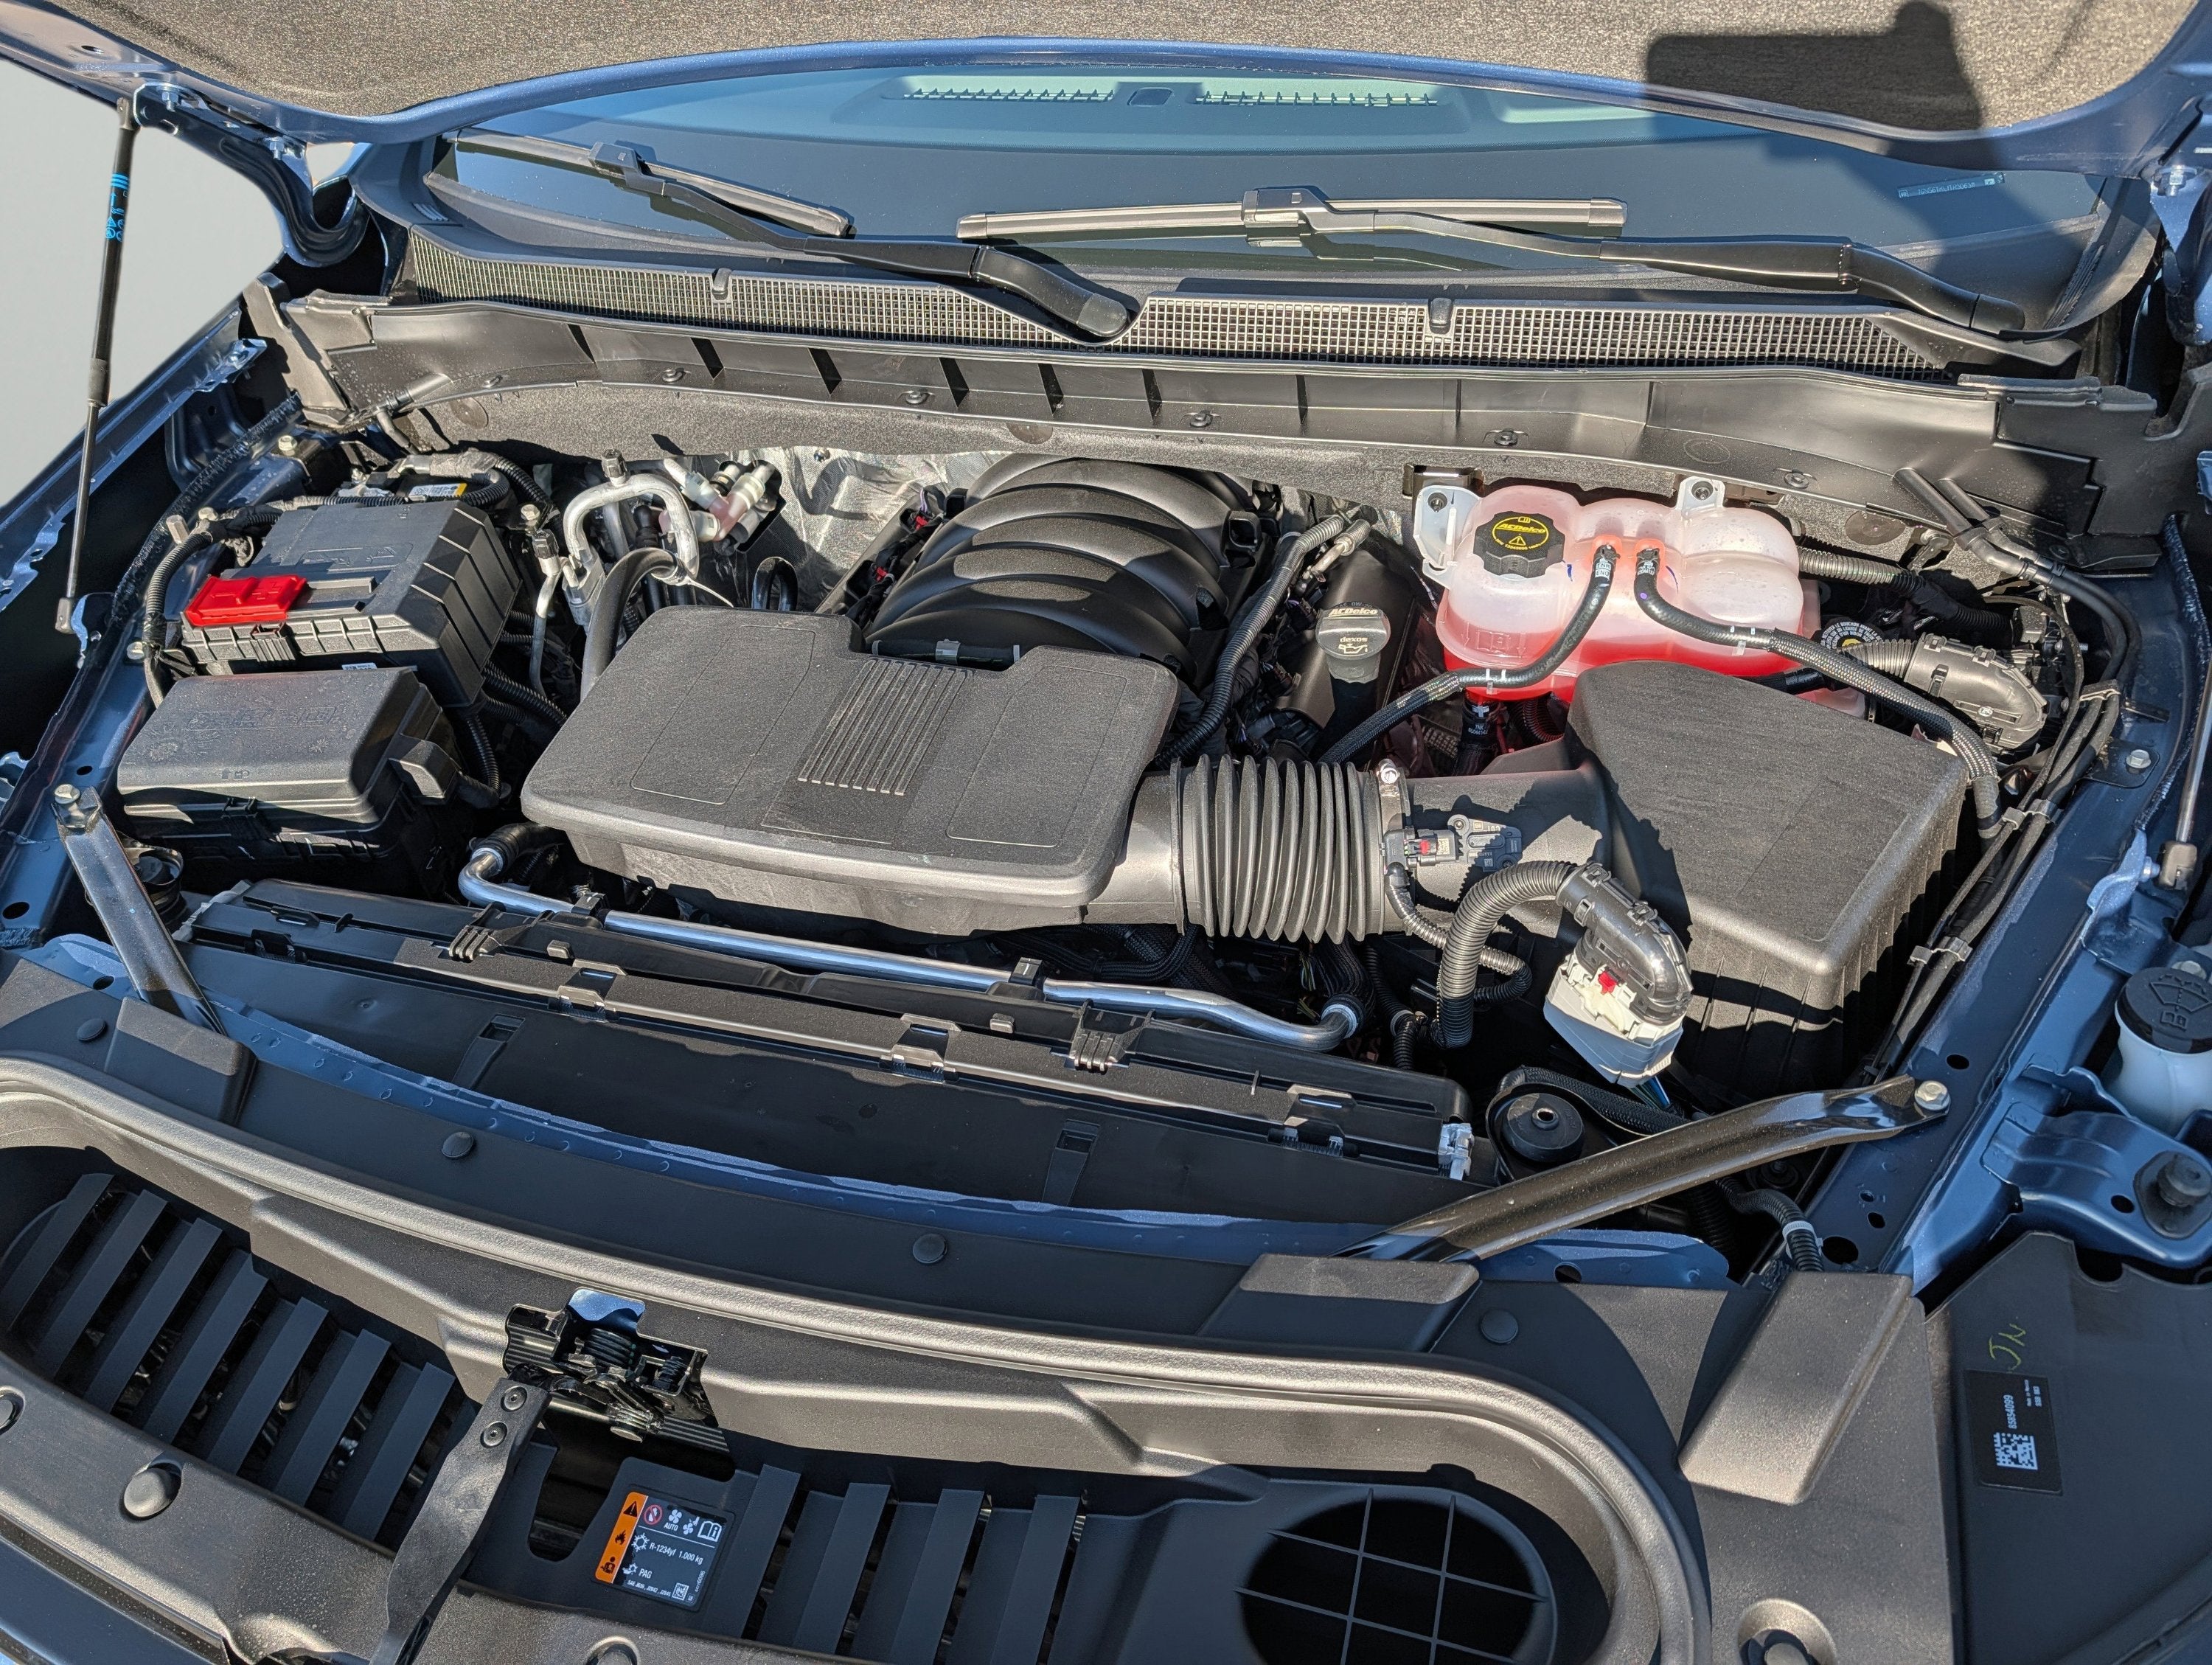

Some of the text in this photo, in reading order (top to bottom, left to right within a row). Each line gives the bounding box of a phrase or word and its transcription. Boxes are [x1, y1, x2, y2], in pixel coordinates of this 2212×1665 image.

[1496, 524, 1545, 534] ACDelco
[1328, 608, 1378, 617] ACDelco
[664, 1522, 679, 1532] AUTO
[649, 1542, 703, 1565] R-1234yf 1.000 kg
[639, 1568, 653, 1579] PAG
